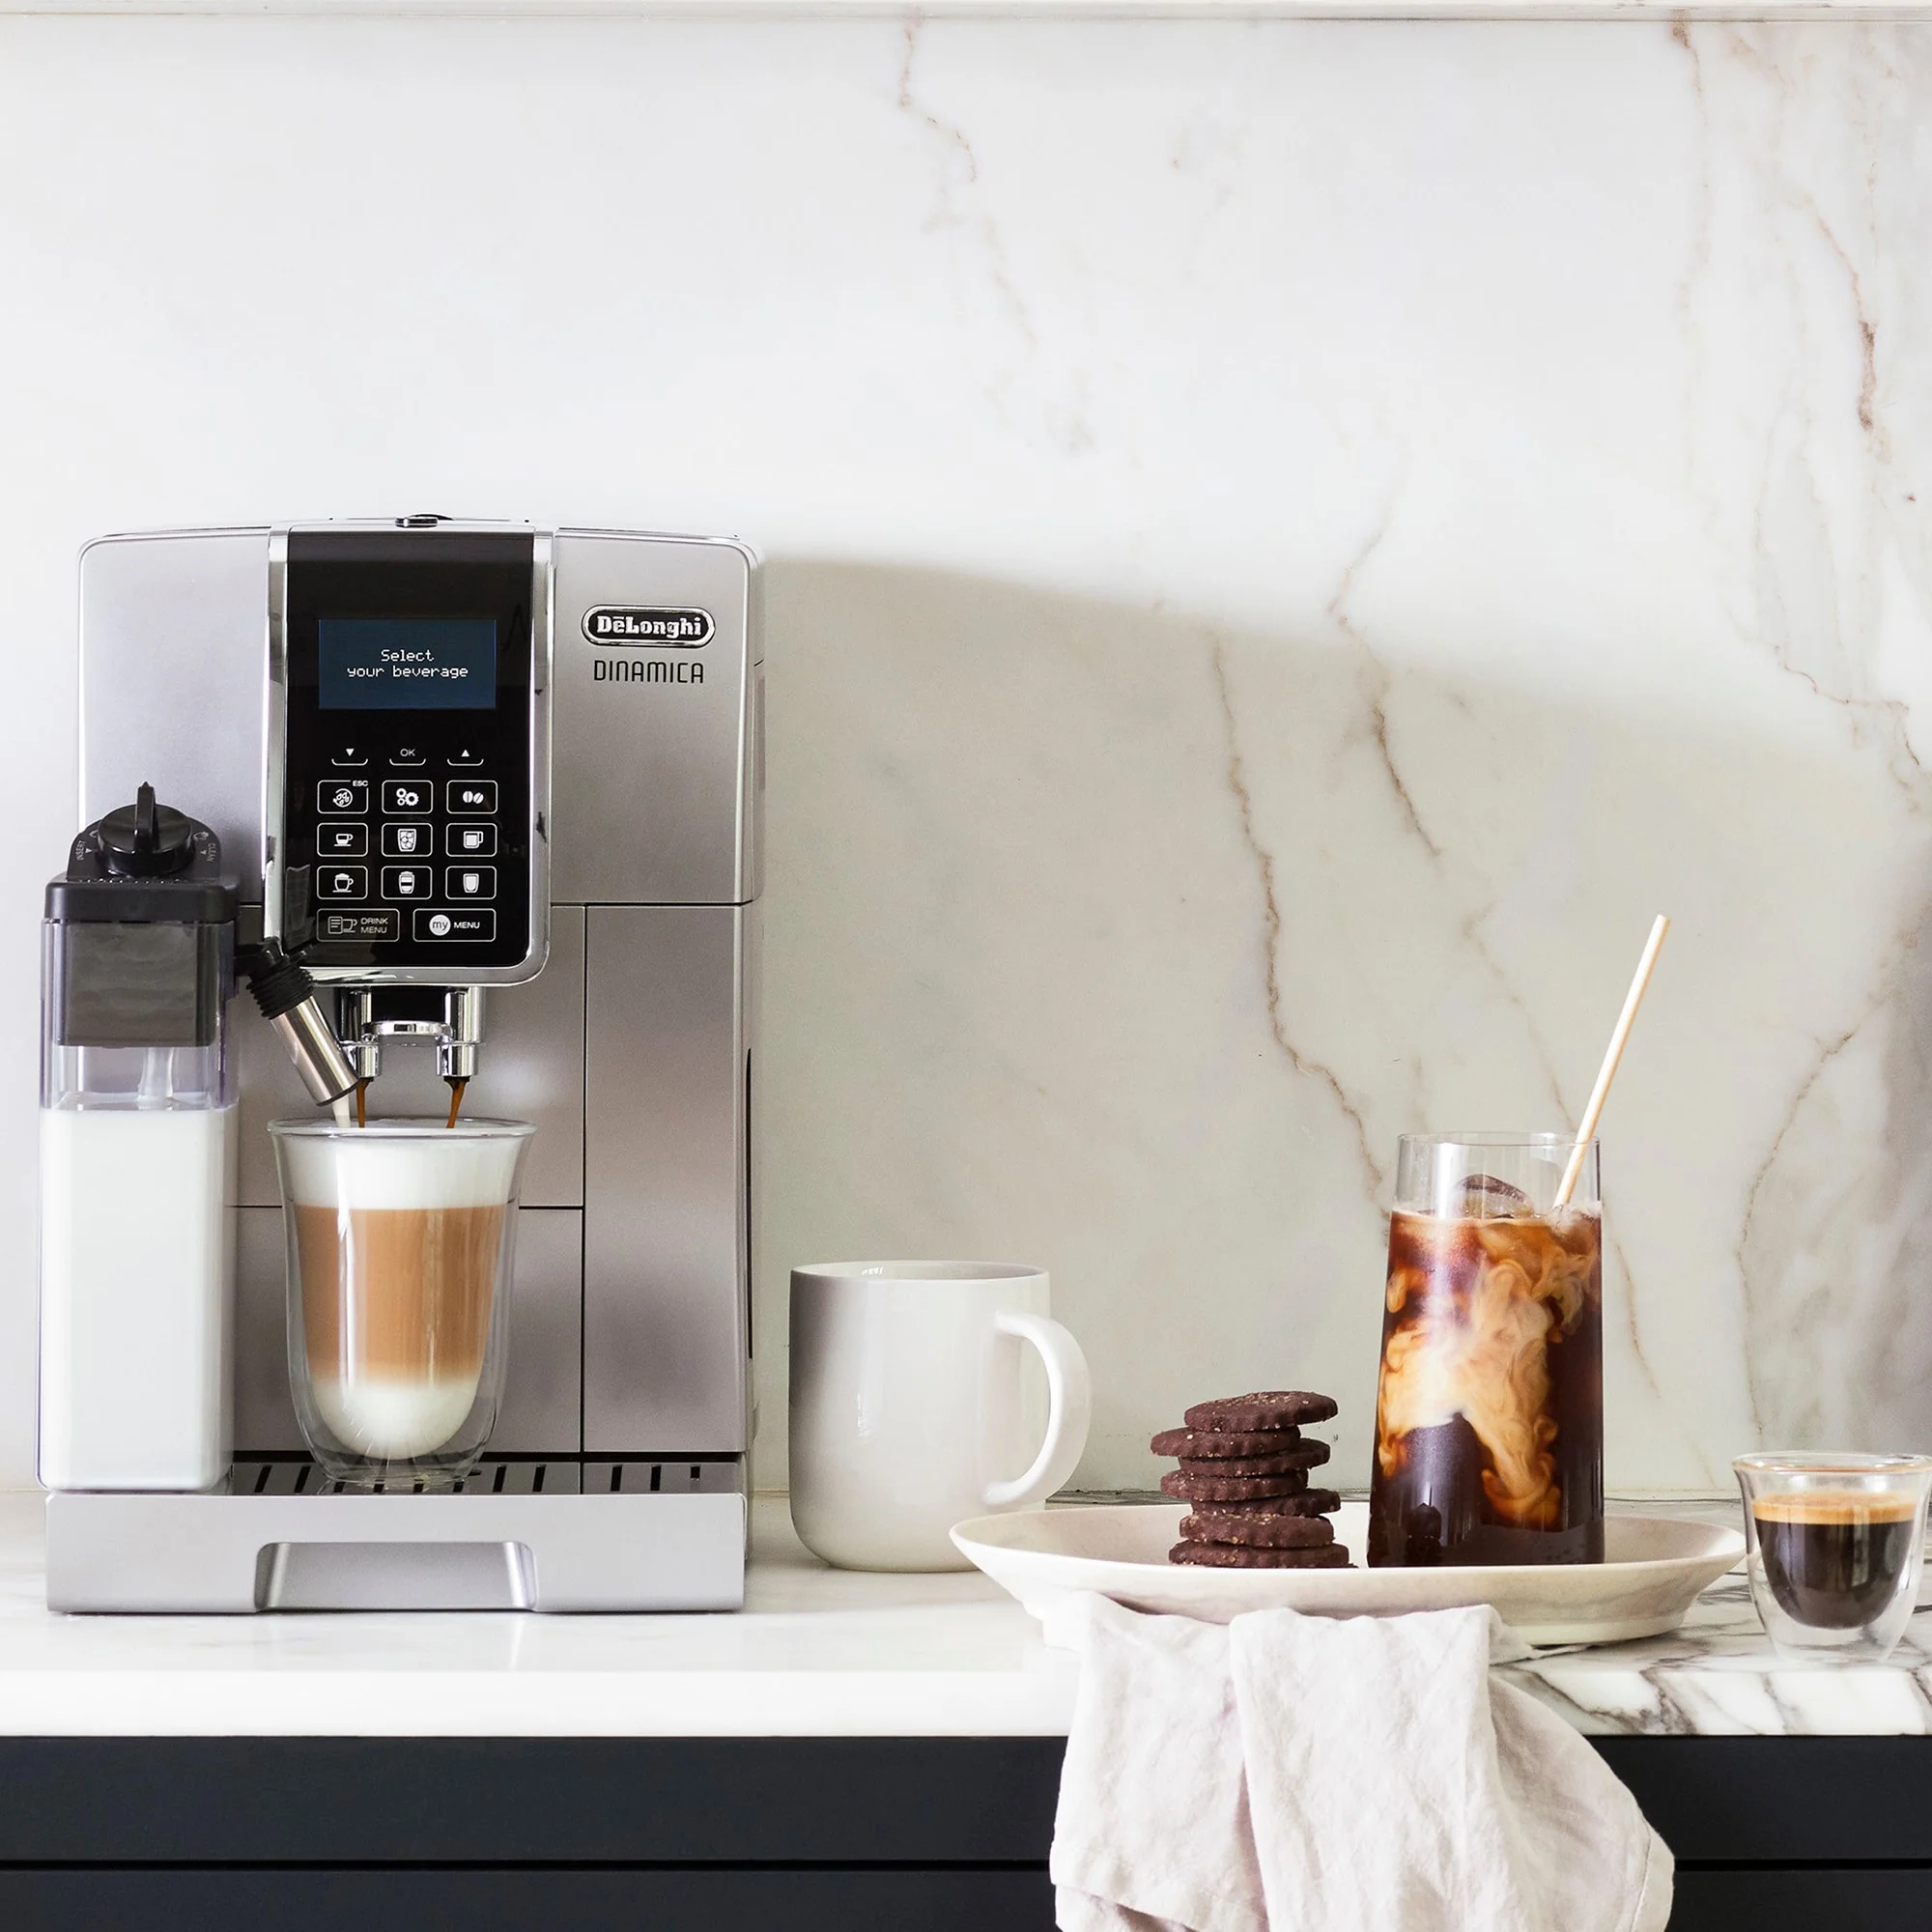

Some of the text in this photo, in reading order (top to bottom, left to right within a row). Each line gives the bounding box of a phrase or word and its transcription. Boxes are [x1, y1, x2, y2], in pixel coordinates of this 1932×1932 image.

[381, 649, 435, 662] Select
[347, 665, 469, 679] your beverage
[594, 660, 704, 684] DINAMICA
[400, 748, 416, 757] OK
[360, 917, 388, 925] DRINK
[432, 920, 449, 931] my
